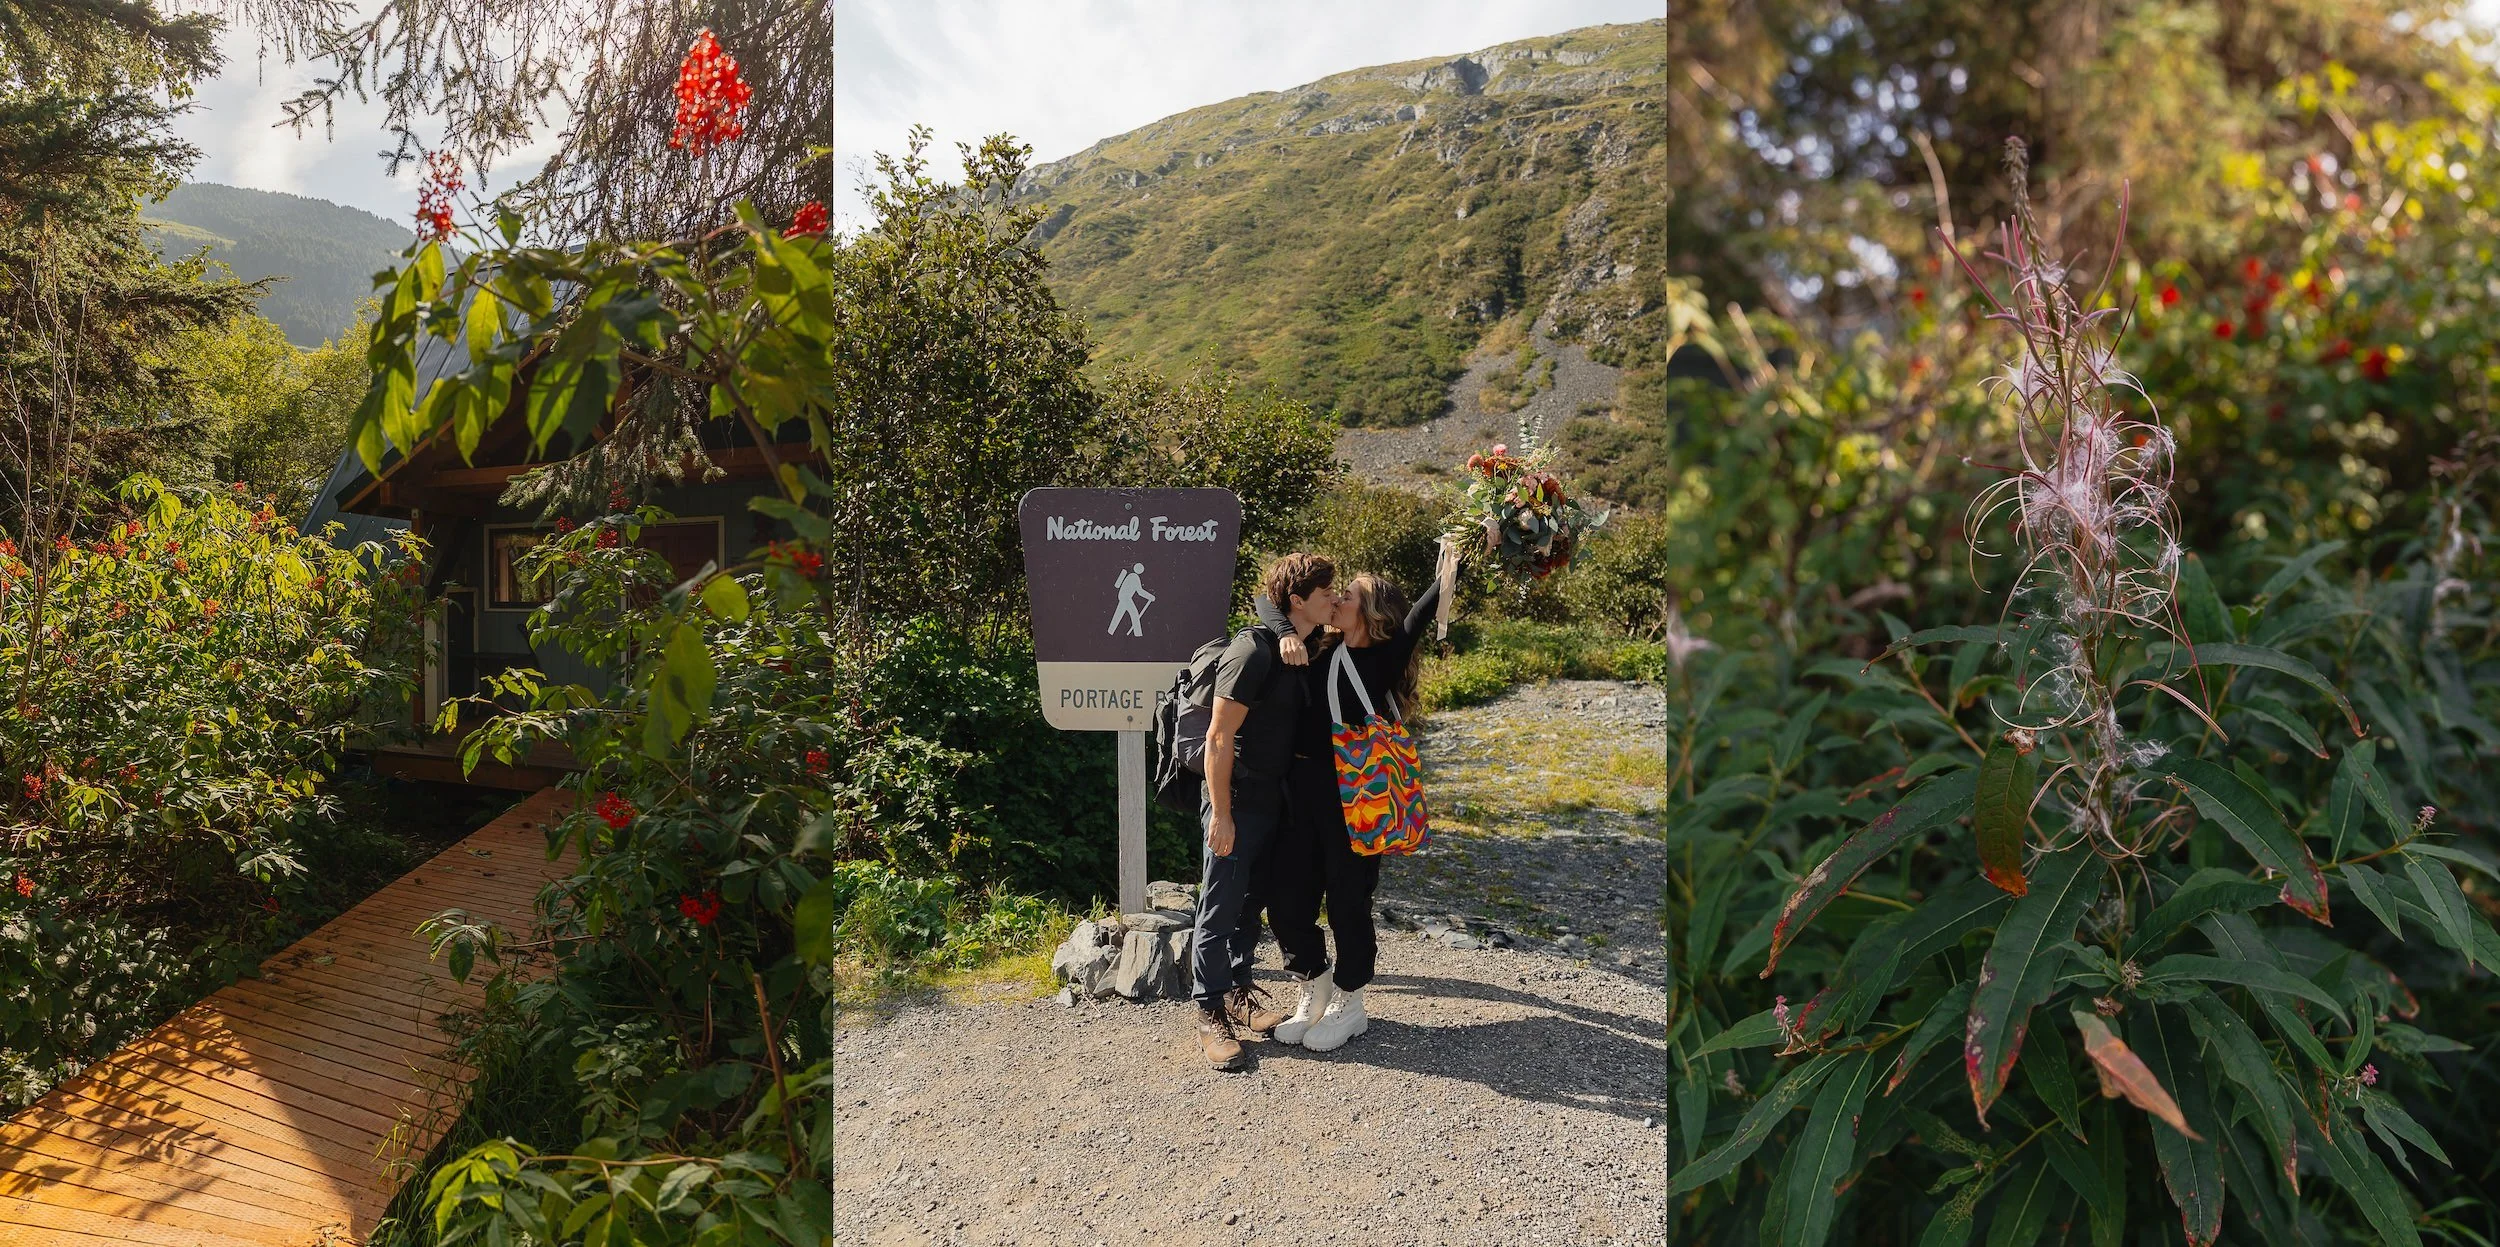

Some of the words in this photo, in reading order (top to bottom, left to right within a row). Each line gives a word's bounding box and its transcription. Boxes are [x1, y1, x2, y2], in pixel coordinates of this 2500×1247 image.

[1047, 516, 1141, 541] National
[1150, 516, 1218, 542] Forest
[1060, 689, 1144, 709] PORTAGE
